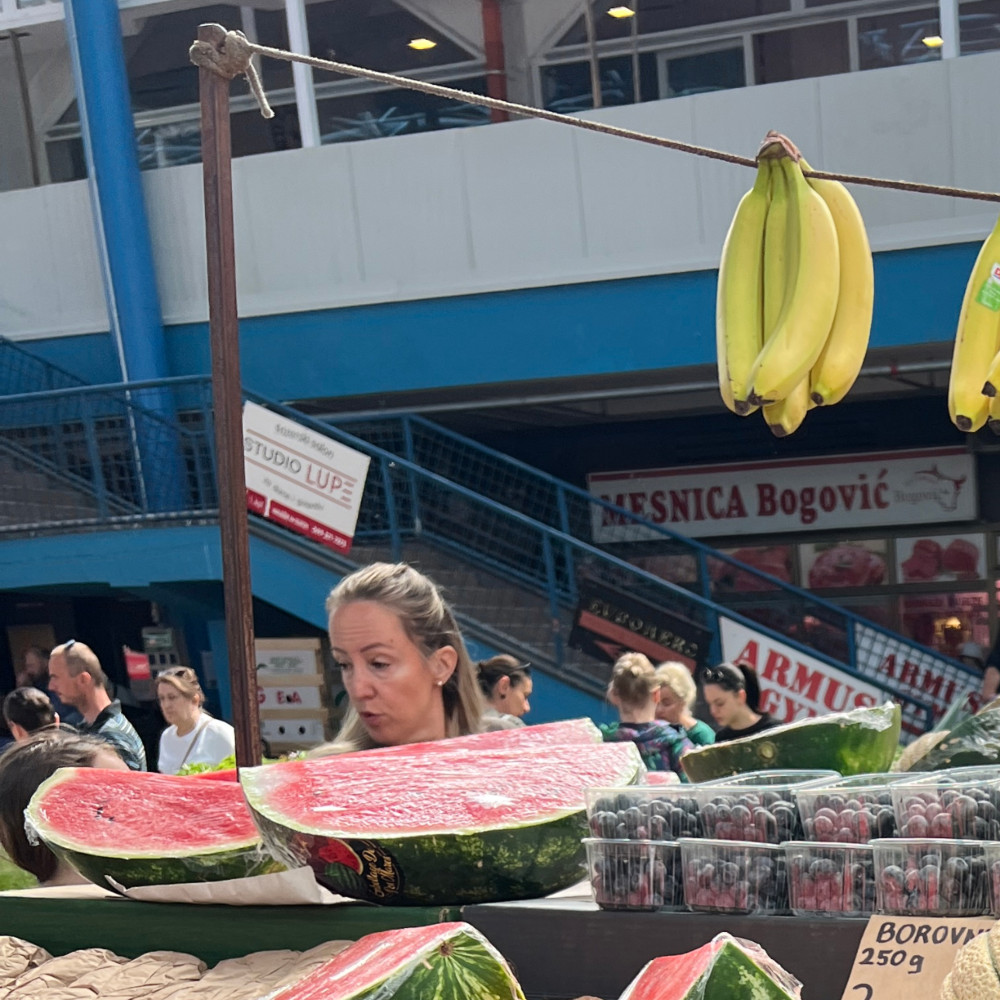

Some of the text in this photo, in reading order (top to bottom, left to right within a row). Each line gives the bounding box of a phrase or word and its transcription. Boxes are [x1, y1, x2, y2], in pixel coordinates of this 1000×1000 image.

[244, 436, 302, 474] STUDIO
[602, 468, 890, 528] MESNICA Bogović
[734, 638, 878, 711] ARMUS
[876, 921, 991, 946] BOROVN
